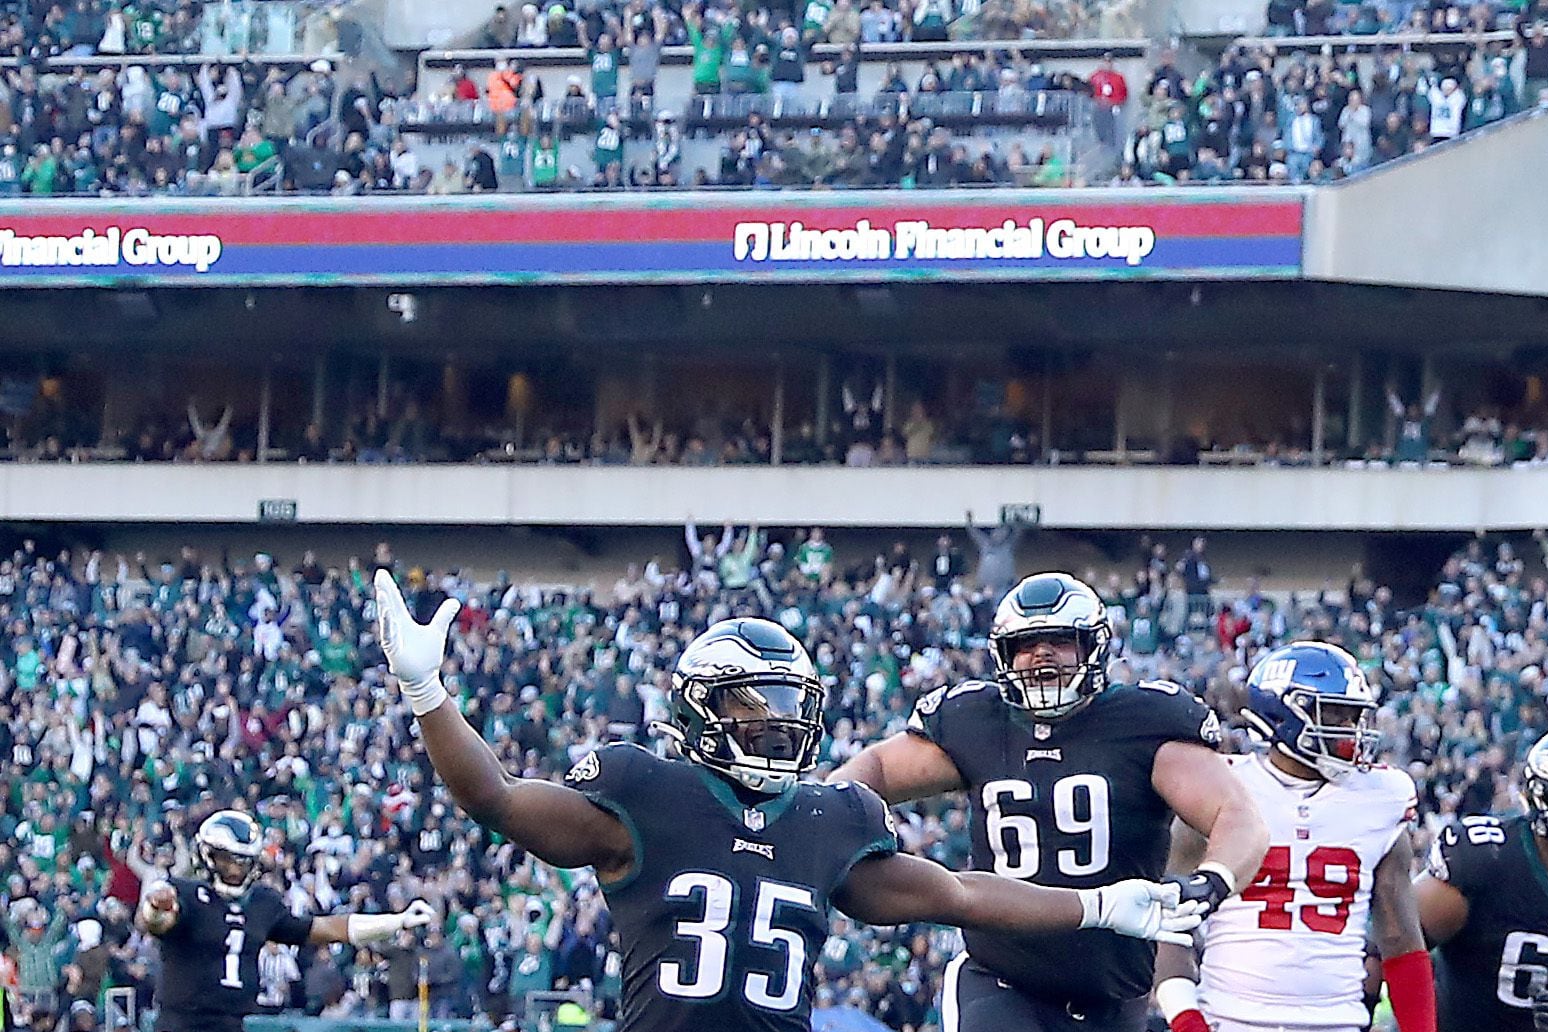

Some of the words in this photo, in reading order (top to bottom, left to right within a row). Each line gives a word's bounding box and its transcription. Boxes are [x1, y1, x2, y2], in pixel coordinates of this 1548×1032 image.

[121, 228, 223, 272] Group
[769, 220, 892, 261] Lincoln
[894, 217, 1044, 260] Financial
[1045, 219, 1155, 266] Group
[733, 838, 775, 860] EAGLES
[982, 774, 1110, 880] 69
[1241, 846, 1362, 935] 49
[219, 928, 246, 989] 1
[659, 871, 814, 1011] 35
